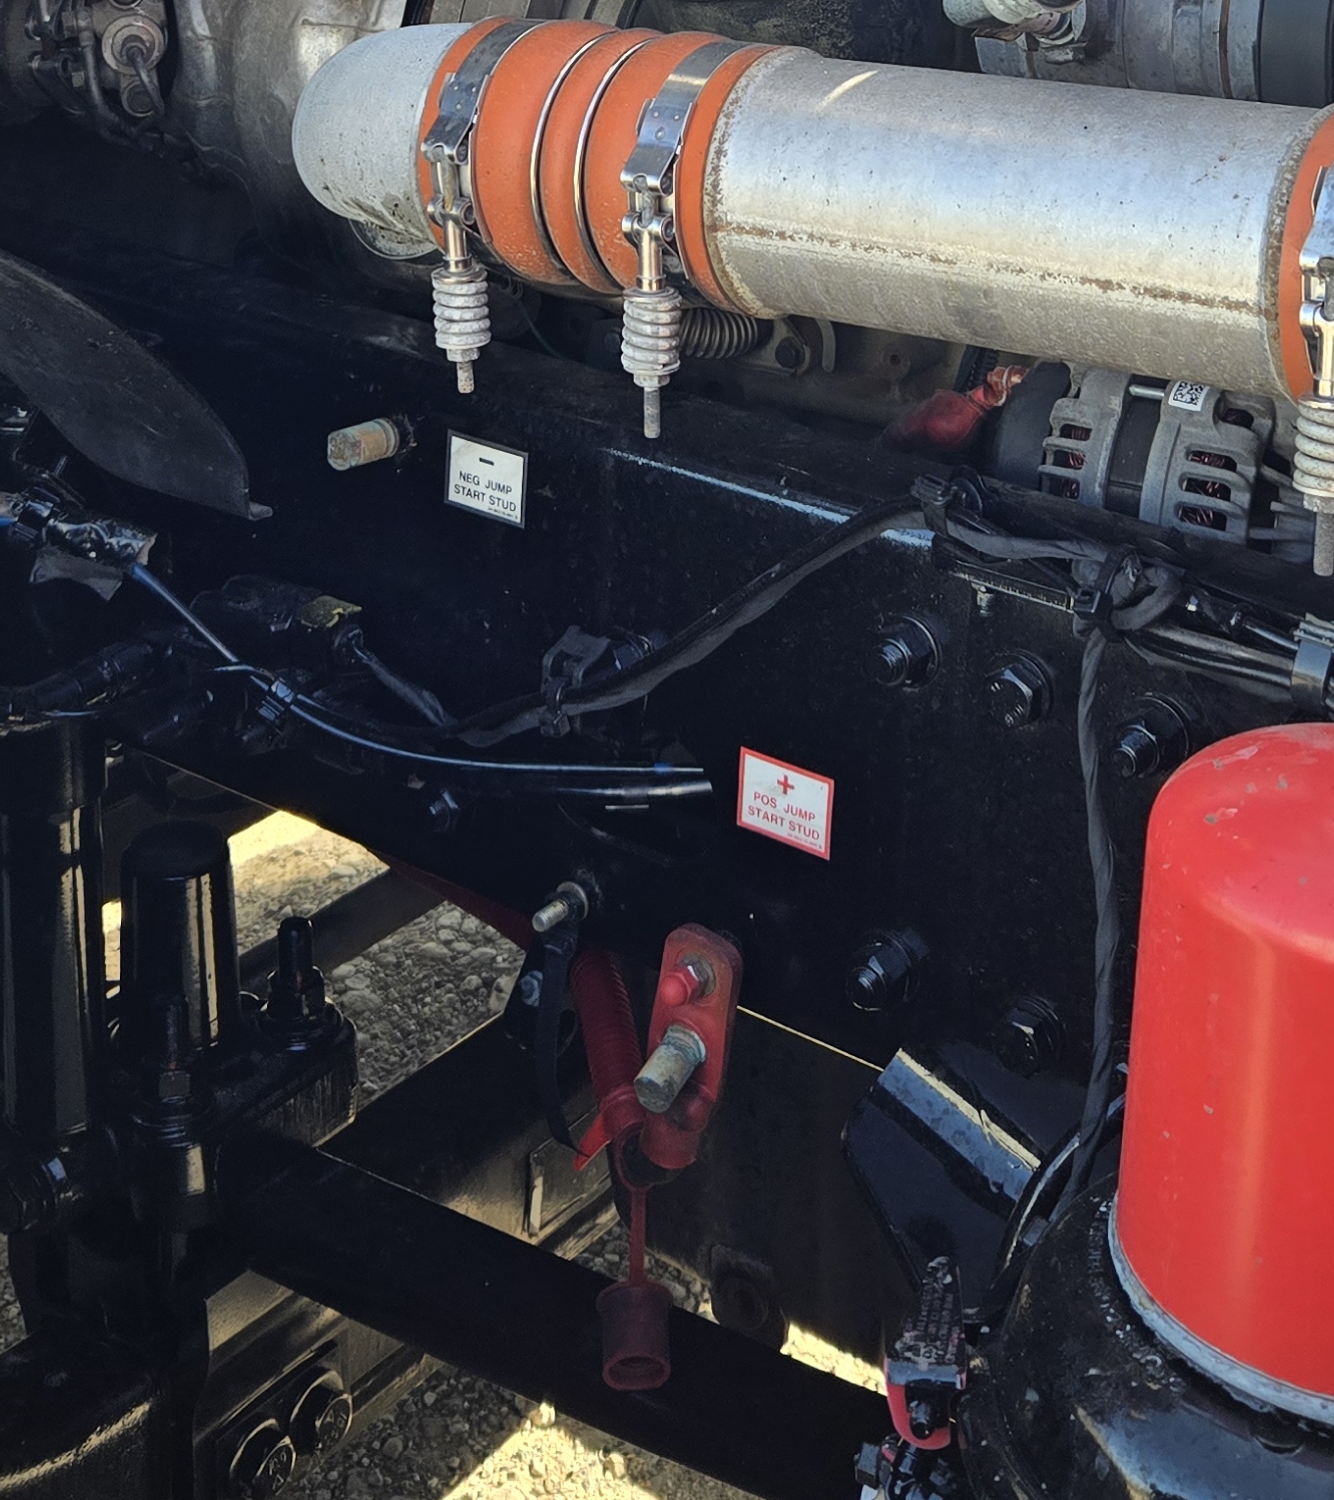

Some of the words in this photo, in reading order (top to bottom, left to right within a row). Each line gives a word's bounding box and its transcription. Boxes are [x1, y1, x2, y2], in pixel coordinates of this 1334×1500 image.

[454, 483, 487, 502] START
[488, 495, 517, 512] STUD
[458, 470, 480, 486] NEG
[485, 479, 513, 495] JUMP
[753, 791, 777, 809] POS
[783, 803, 816, 822] JUMP
[747, 805, 786, 828] START
[788, 820, 820, 841] STUD
